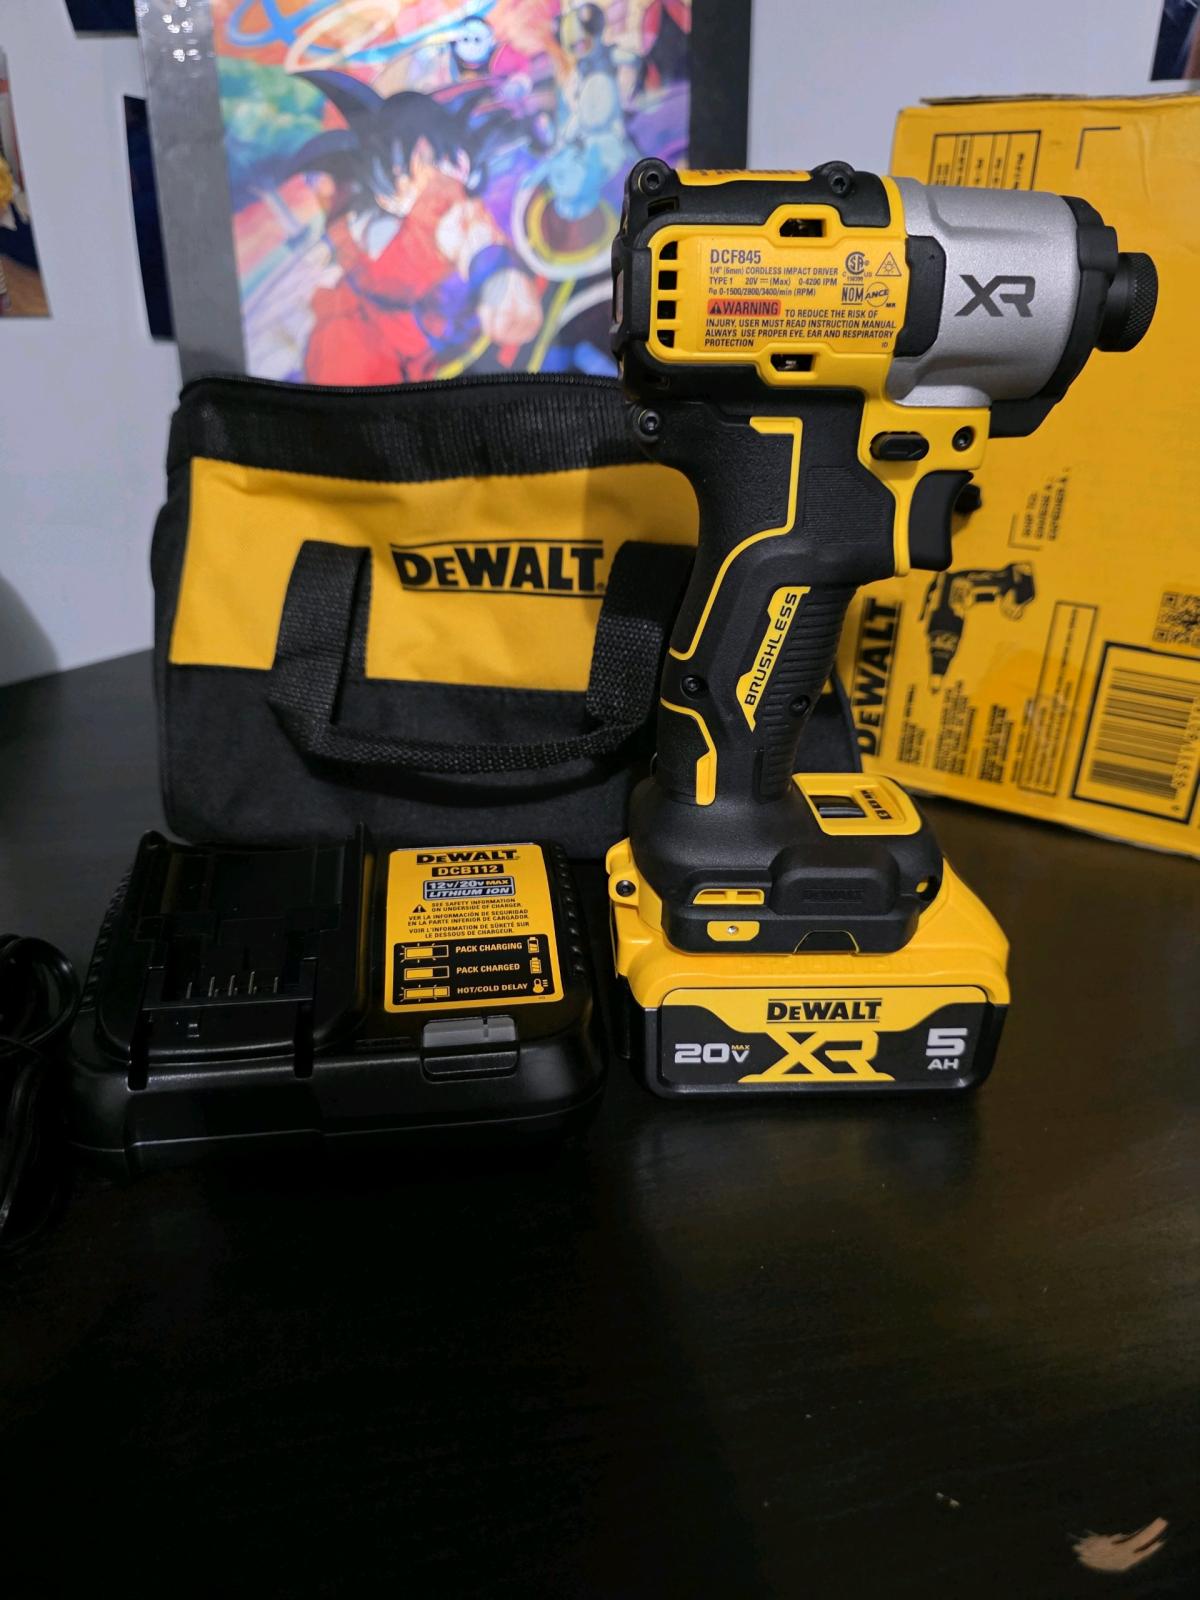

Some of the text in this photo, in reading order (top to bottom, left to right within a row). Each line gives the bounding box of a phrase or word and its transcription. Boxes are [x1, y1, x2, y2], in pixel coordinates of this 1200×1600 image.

[710, 249, 762, 264] DCF845
[745, 266, 782, 275] CORDLESS
[783, 267, 811, 276] IMPACT
[812, 267, 839, 276] DRIVER
[709, 276, 728, 285] TYPE
[744, 277, 759, 286] 20V
[769, 277, 792, 286] (Max)
[822, 278, 838, 286] IPM
[793, 288, 816, 297] (RPM)
[842, 287, 864, 302] NOM
[865, 289, 889, 300] ANCE
[954, 274, 1036, 318] XR
[723, 301, 878, 318] WARNING TO REDUCE THE RISK OF
[738, 319, 760, 328] USER
[761, 319, 784, 328] MUST
[785, 319, 807, 328] READ
[807, 319, 860, 328] INSTRUCTION
[705, 329, 737, 338] ALWAYS
[741, 330, 756, 338] USE
[757, 330, 788, 338] PROPER
[806, 330, 822, 338] EAR
[823, 330, 841, 338] AND
[842, 330, 894, 339] RESPIRATORY
[704, 339, 755, 348] PROTECTION
[391, 546, 604, 593] DEWALT
[744, 592, 798, 706] BRUSHLESS
[437, 865, 499, 876] DCB112
[429, 887, 510, 898] LITHIUM ION
[491, 908, 529, 916] SEGURIDAD
[451, 916, 481, 924] INFERIOR
[435, 930, 466, 938] DESSOUS
[455, 942, 523, 954] PACK CHARGING
[456, 963, 521, 974] PACK CHARGED
[457, 982, 528, 994] HOT/COLD DELAY
[766, 1001, 882, 1021] DEWALT
[925, 1027, 968, 1056] 5
[737, 1031, 896, 1082] XR
[928, 1058, 959, 1070] AH
